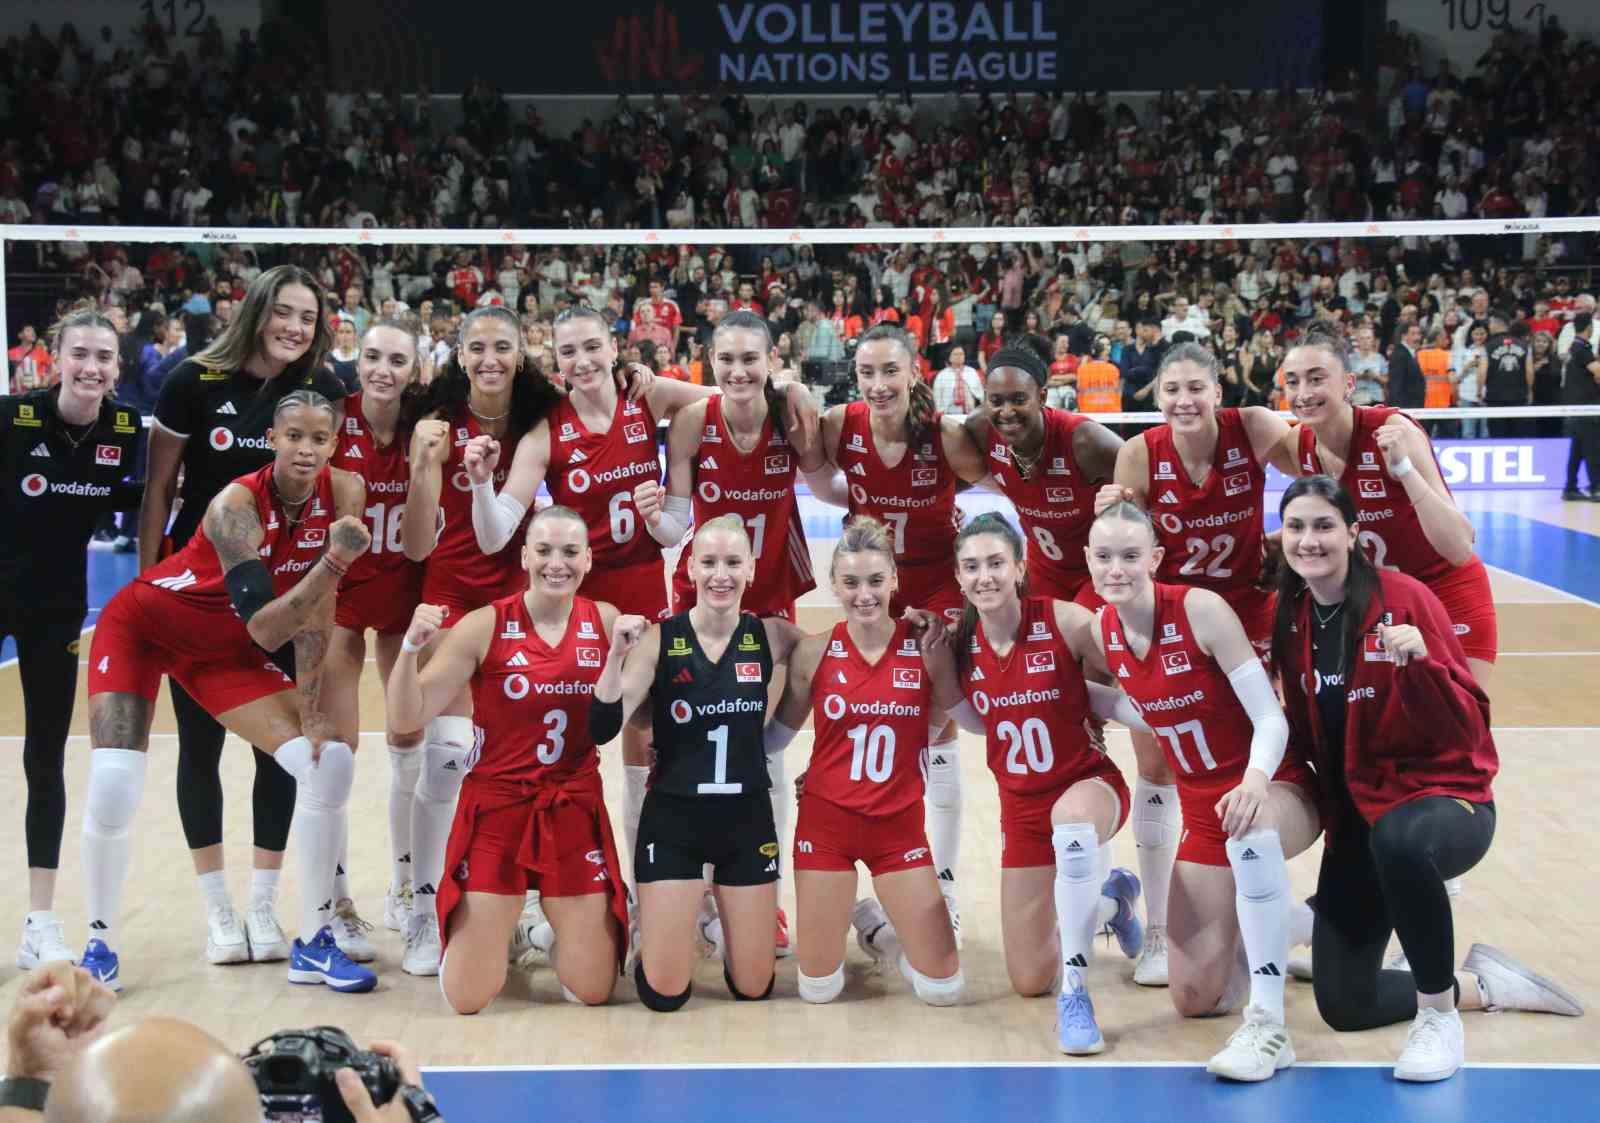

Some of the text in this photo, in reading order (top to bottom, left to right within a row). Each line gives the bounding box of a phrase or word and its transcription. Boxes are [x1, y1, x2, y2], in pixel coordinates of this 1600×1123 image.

[719, 2, 1057, 43] VOLLEYBALL
[1441, 0, 1511, 30] 109
[719, 52, 1057, 82] NATIONS LEAGUE
[593, 459, 657, 484] vodafone
[1434, 445, 1546, 484] STEL
[50, 481, 111, 496] vodafone
[871, 492, 937, 508] vodafone
[608, 491, 635, 544] 6
[1017, 505, 1080, 518] vodafone
[1185, 506, 1254, 528] vodafone
[746, 513, 766, 560] 1
[884, 512, 907, 554] 7
[1031, 526, 1063, 561] 8
[1179, 533, 1235, 578] 22
[97, 655, 109, 674] 4
[696, 698, 763, 716] vodafone
[850, 701, 920, 717] vodafone
[992, 687, 1060, 708] vodafone
[1143, 689, 1204, 712] vodafone
[536, 708, 568, 765] 3
[997, 717, 1055, 775] 20
[1153, 719, 1218, 774] 77
[707, 725, 729, 784] 1
[847, 723, 896, 783] 10
[646, 843, 654, 863] 1
